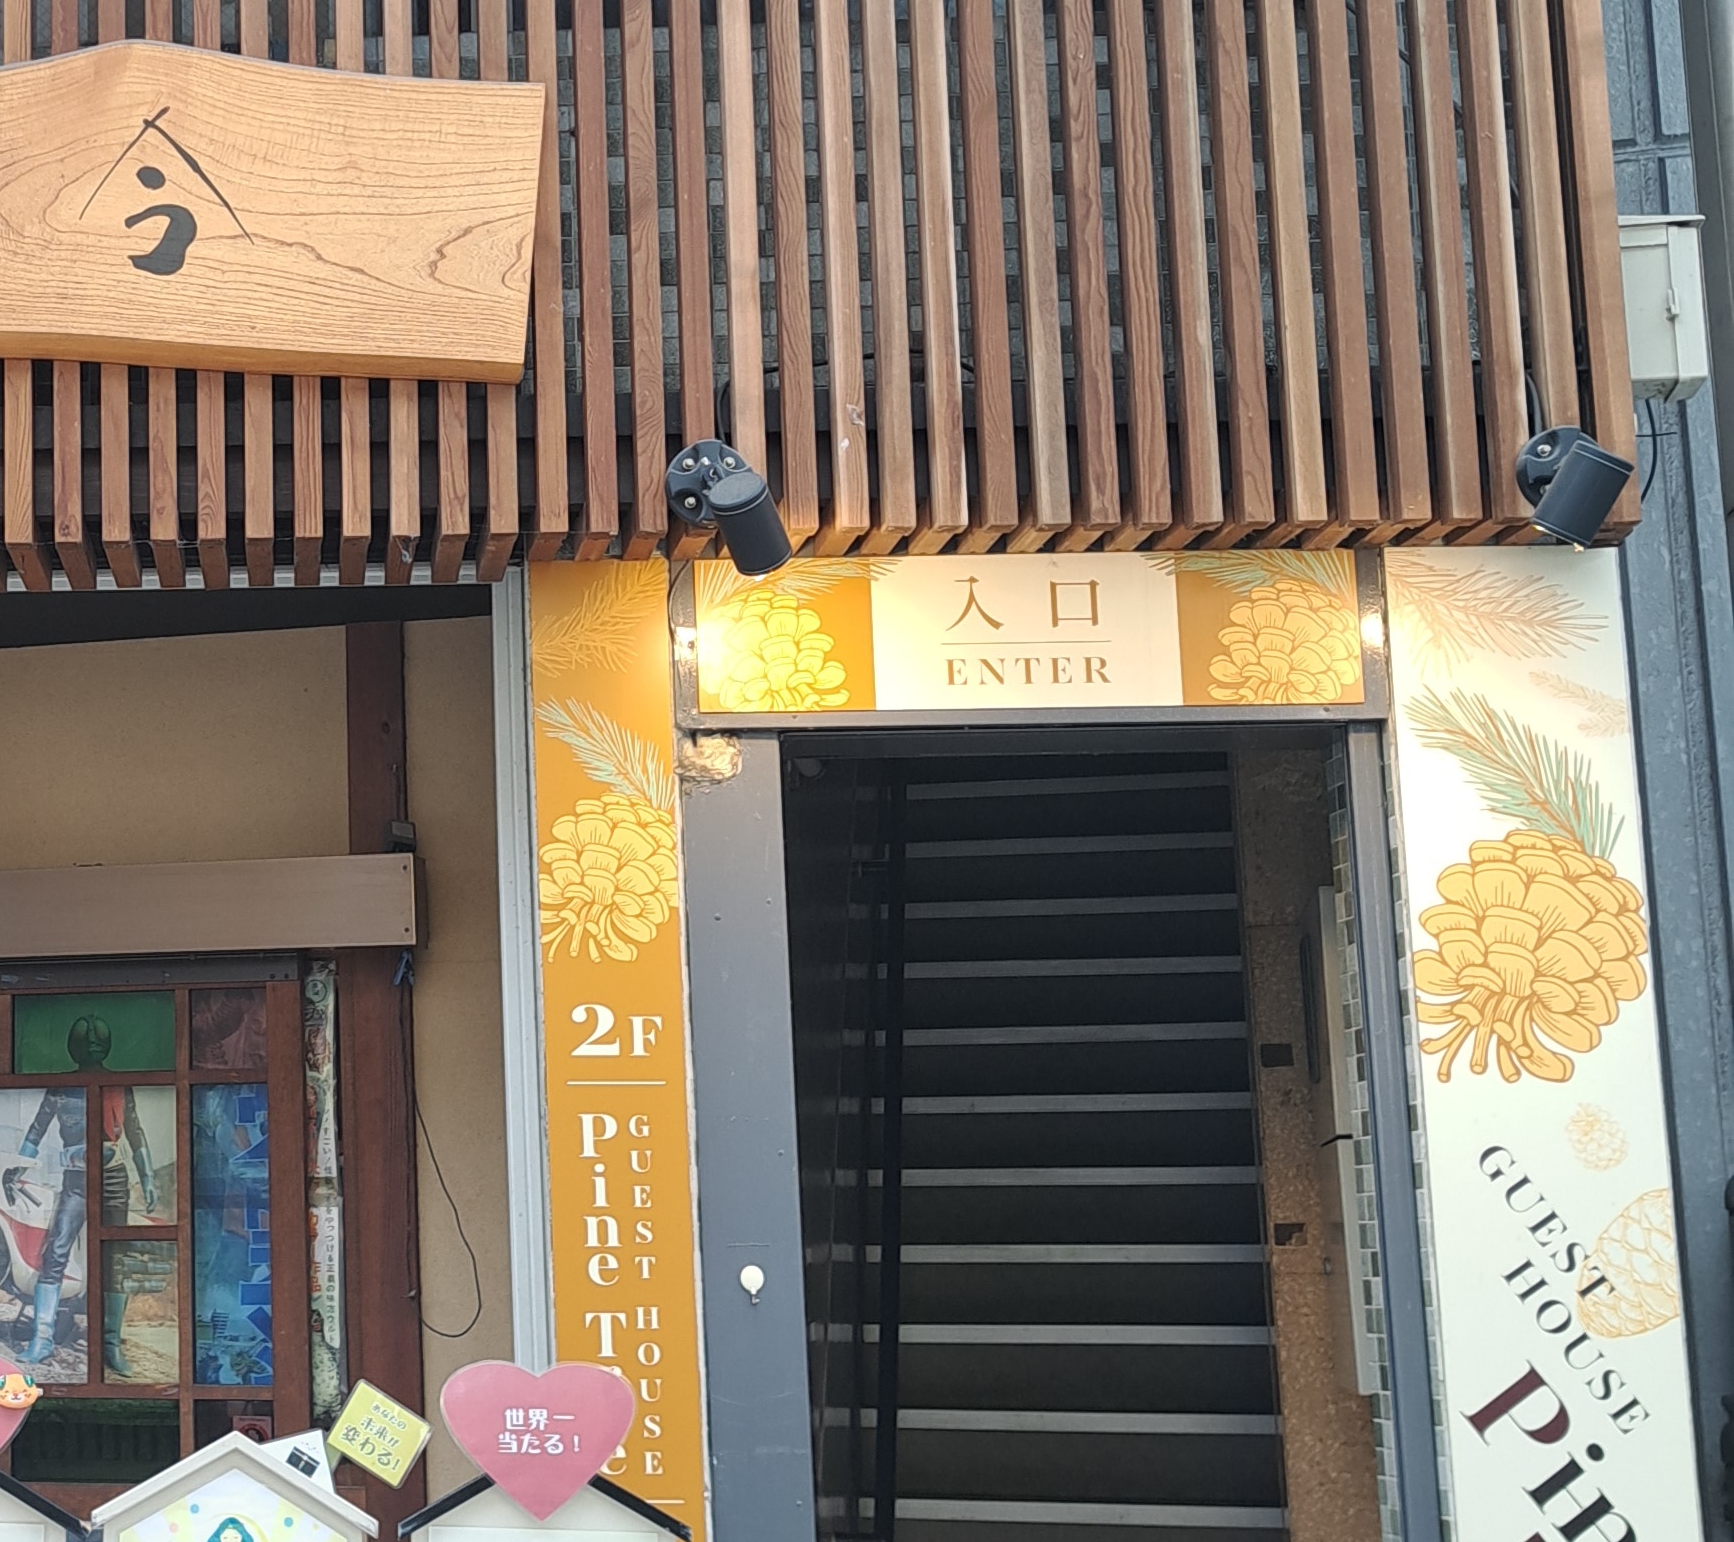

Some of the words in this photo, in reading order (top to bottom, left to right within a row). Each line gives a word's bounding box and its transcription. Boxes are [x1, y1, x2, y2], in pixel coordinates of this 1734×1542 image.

[947, 575, 1102, 633] 入口
[947, 654, 1112, 687] ENTER
[570, 1003, 663, 1058] 2F
[577, 1112, 624, 1287] Pine
[627, 1114, 657, 1280] GUEST
[1479, 1145, 1616, 1300] GUEST
[371, 1403, 407, 1431] あなたの
[504, 1408, 575, 1431] 世界一
[584, 1310, 627, 1476] Te
[635, 1306, 664, 1476] HOUSE
[1501, 1258, 1651, 1435] HOUSE
